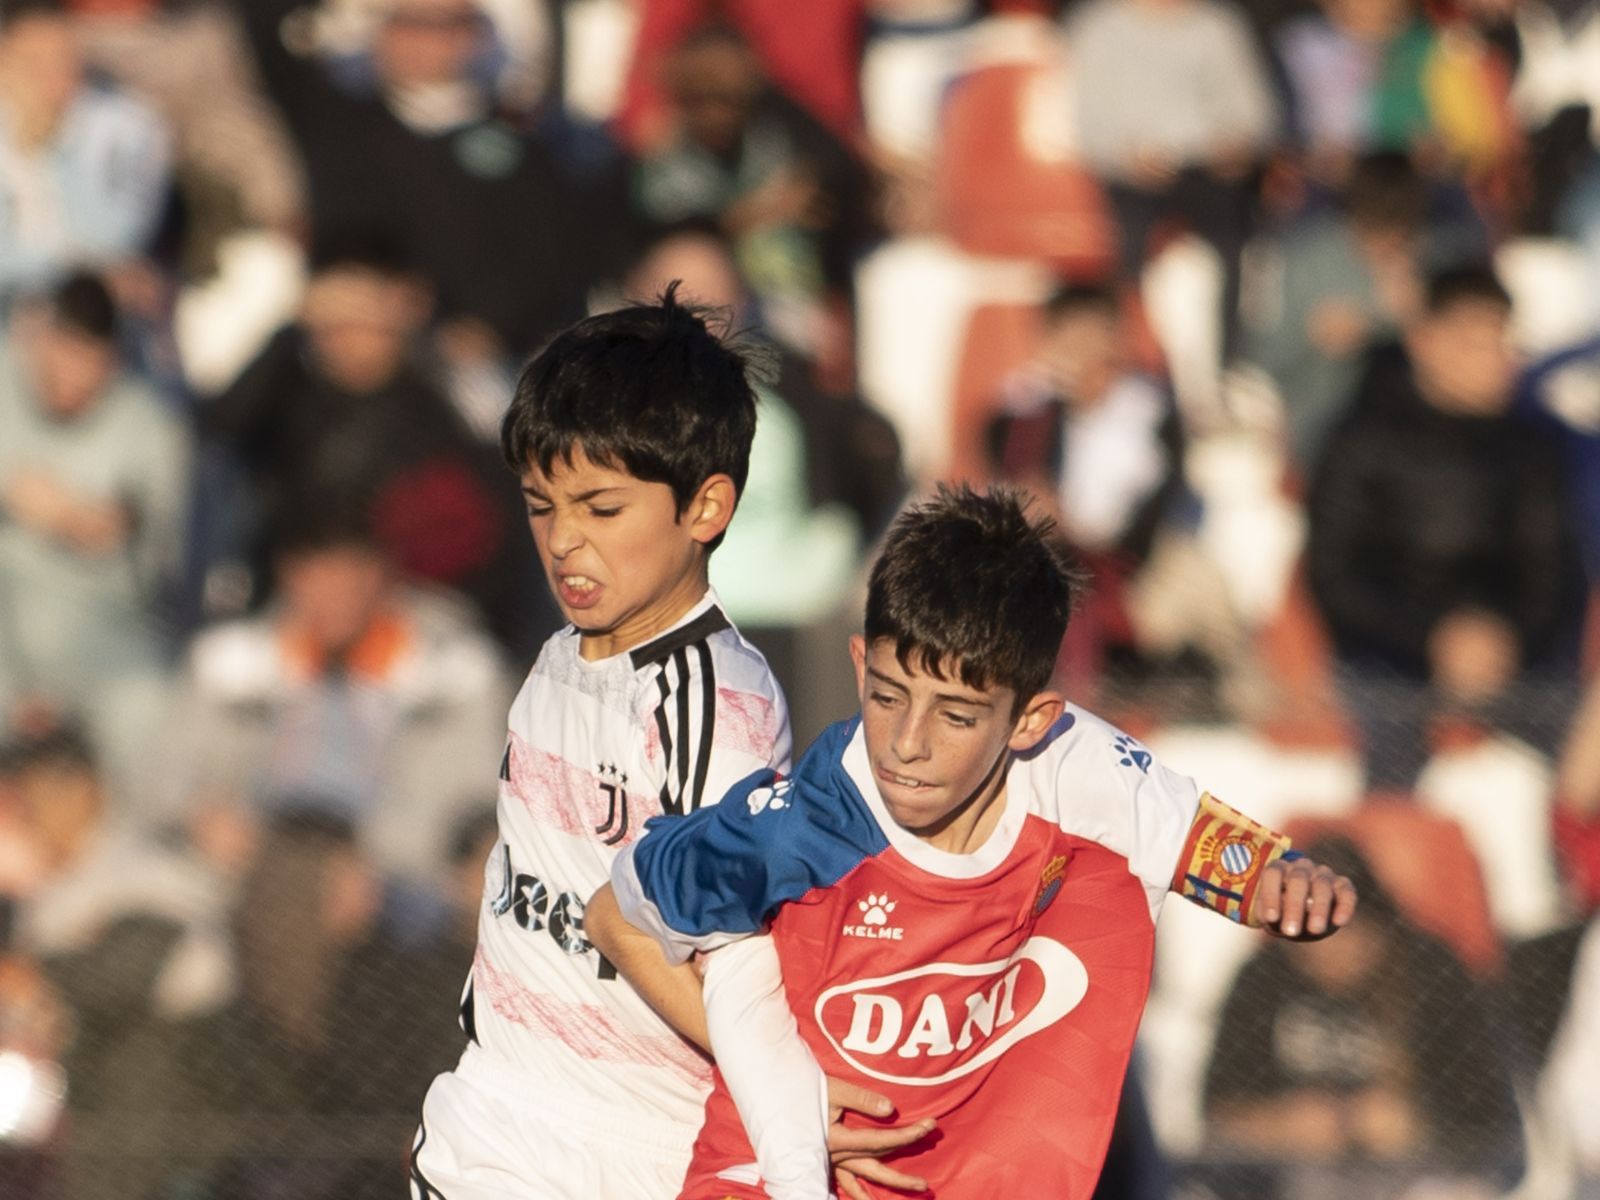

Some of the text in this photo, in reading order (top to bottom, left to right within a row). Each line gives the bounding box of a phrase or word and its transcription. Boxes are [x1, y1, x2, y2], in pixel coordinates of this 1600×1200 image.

[491, 844, 617, 981] Jee
[842, 924, 904, 940] KELME
[841, 965, 1022, 1058] DANI
